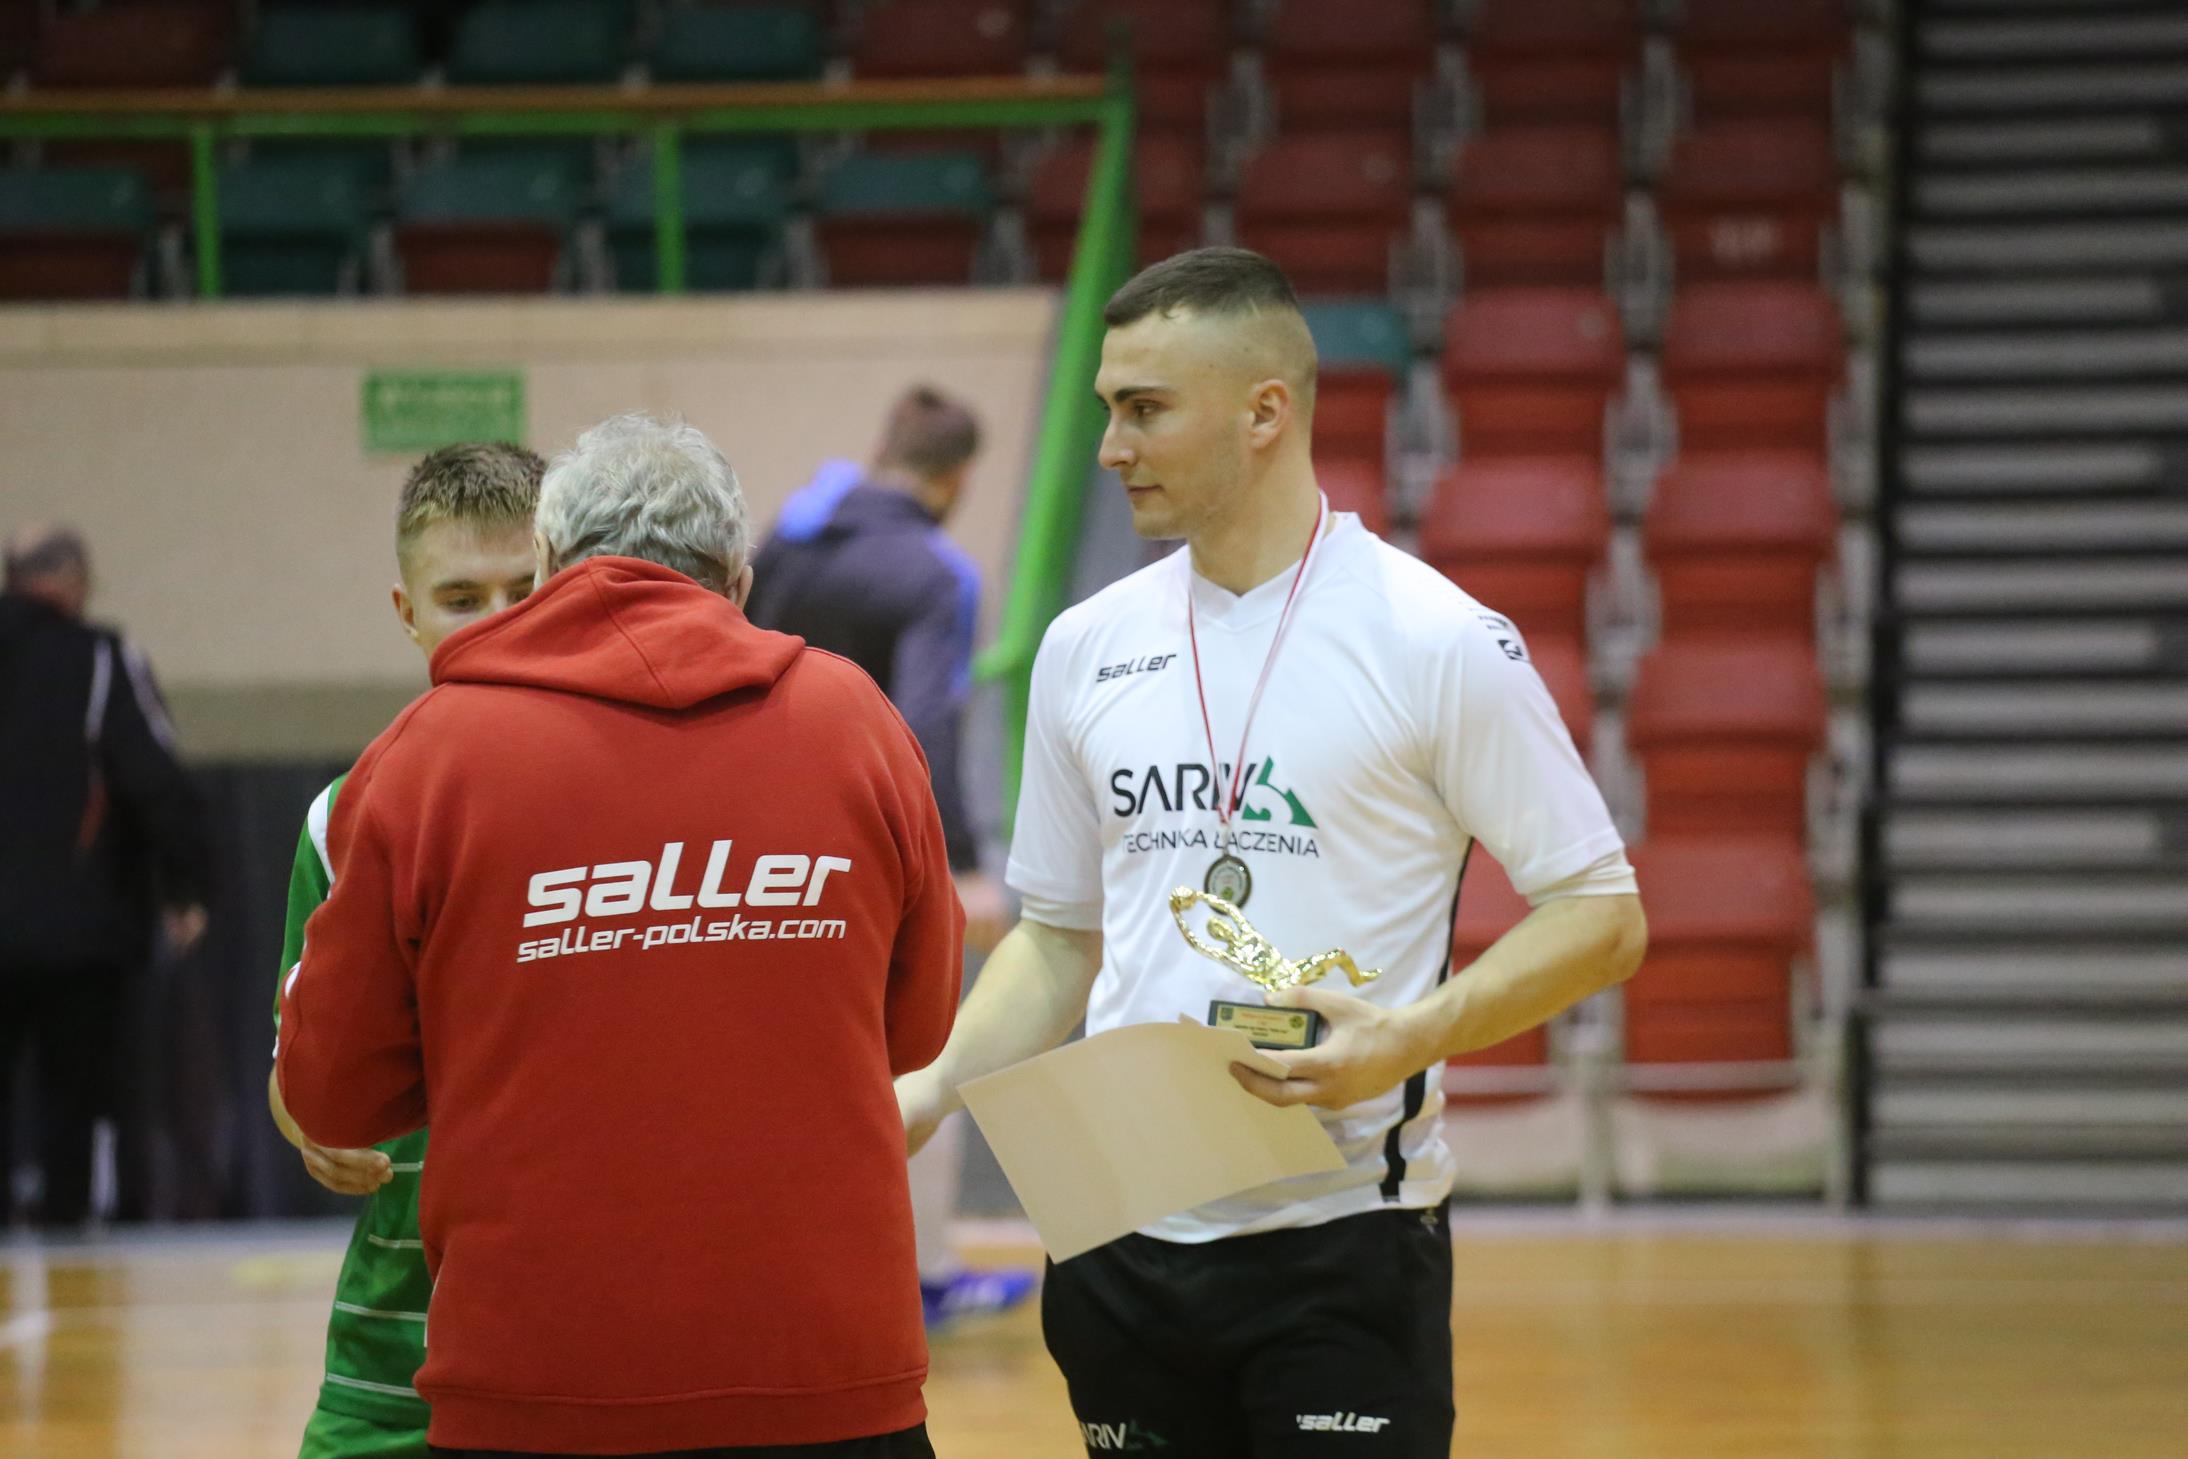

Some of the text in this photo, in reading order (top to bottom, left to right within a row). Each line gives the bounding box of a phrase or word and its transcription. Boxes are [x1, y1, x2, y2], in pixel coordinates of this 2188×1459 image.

[1096, 653, 1177, 683] saller
[1123, 829, 1208, 853] TECHNKA
[523, 839, 852, 929] saller
[516, 913, 847, 964] saller-polska.com
[1297, 1411, 1391, 1433] saller
